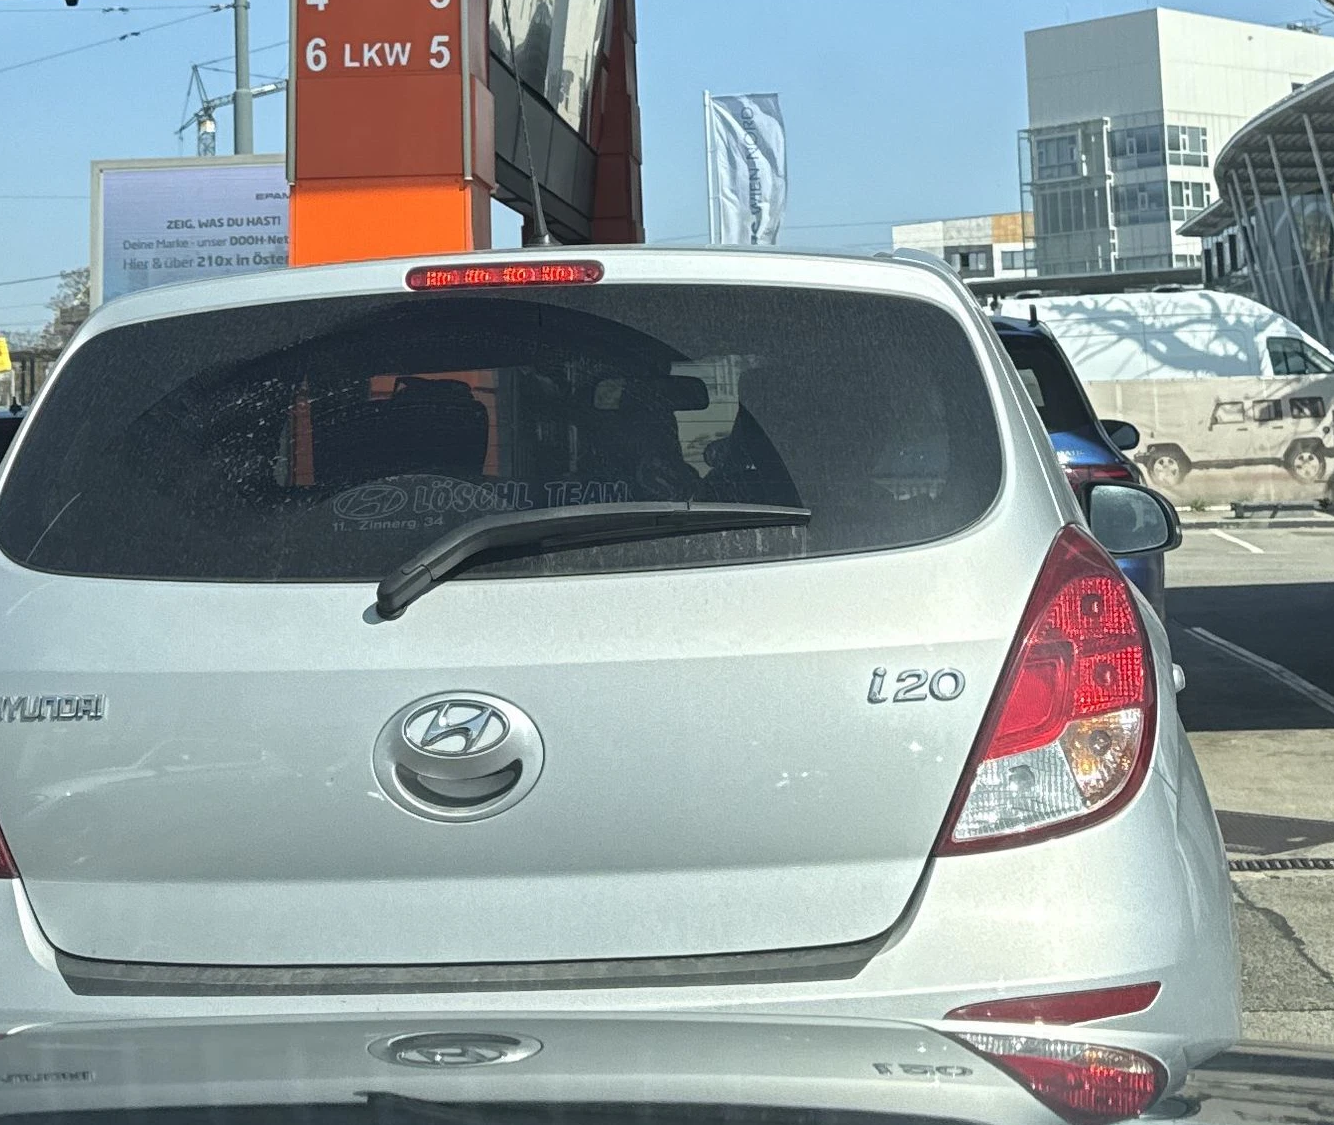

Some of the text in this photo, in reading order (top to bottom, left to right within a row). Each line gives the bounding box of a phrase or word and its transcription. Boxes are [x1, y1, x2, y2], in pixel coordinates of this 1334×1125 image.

[306, 35, 451, 72] 6 LKW 5
[741, 106, 759, 160] NORD
[198, 217, 224, 229] WAS
[227, 216, 244, 228] DU
[123, 239, 154, 251] Deine
[156, 238, 188, 250] Marke
[197, 237, 227, 248] unser
[123, 258, 148, 271] Hier
[152, 257, 163, 269] &
[164, 256, 194, 269] über
[197, 254, 232, 267] 210x
[236, 253, 250, 266] in
[413, 480, 629, 514] LÖSCHL TEAM
[424, 516, 443, 527] 34
[867, 666, 966, 705] i20
